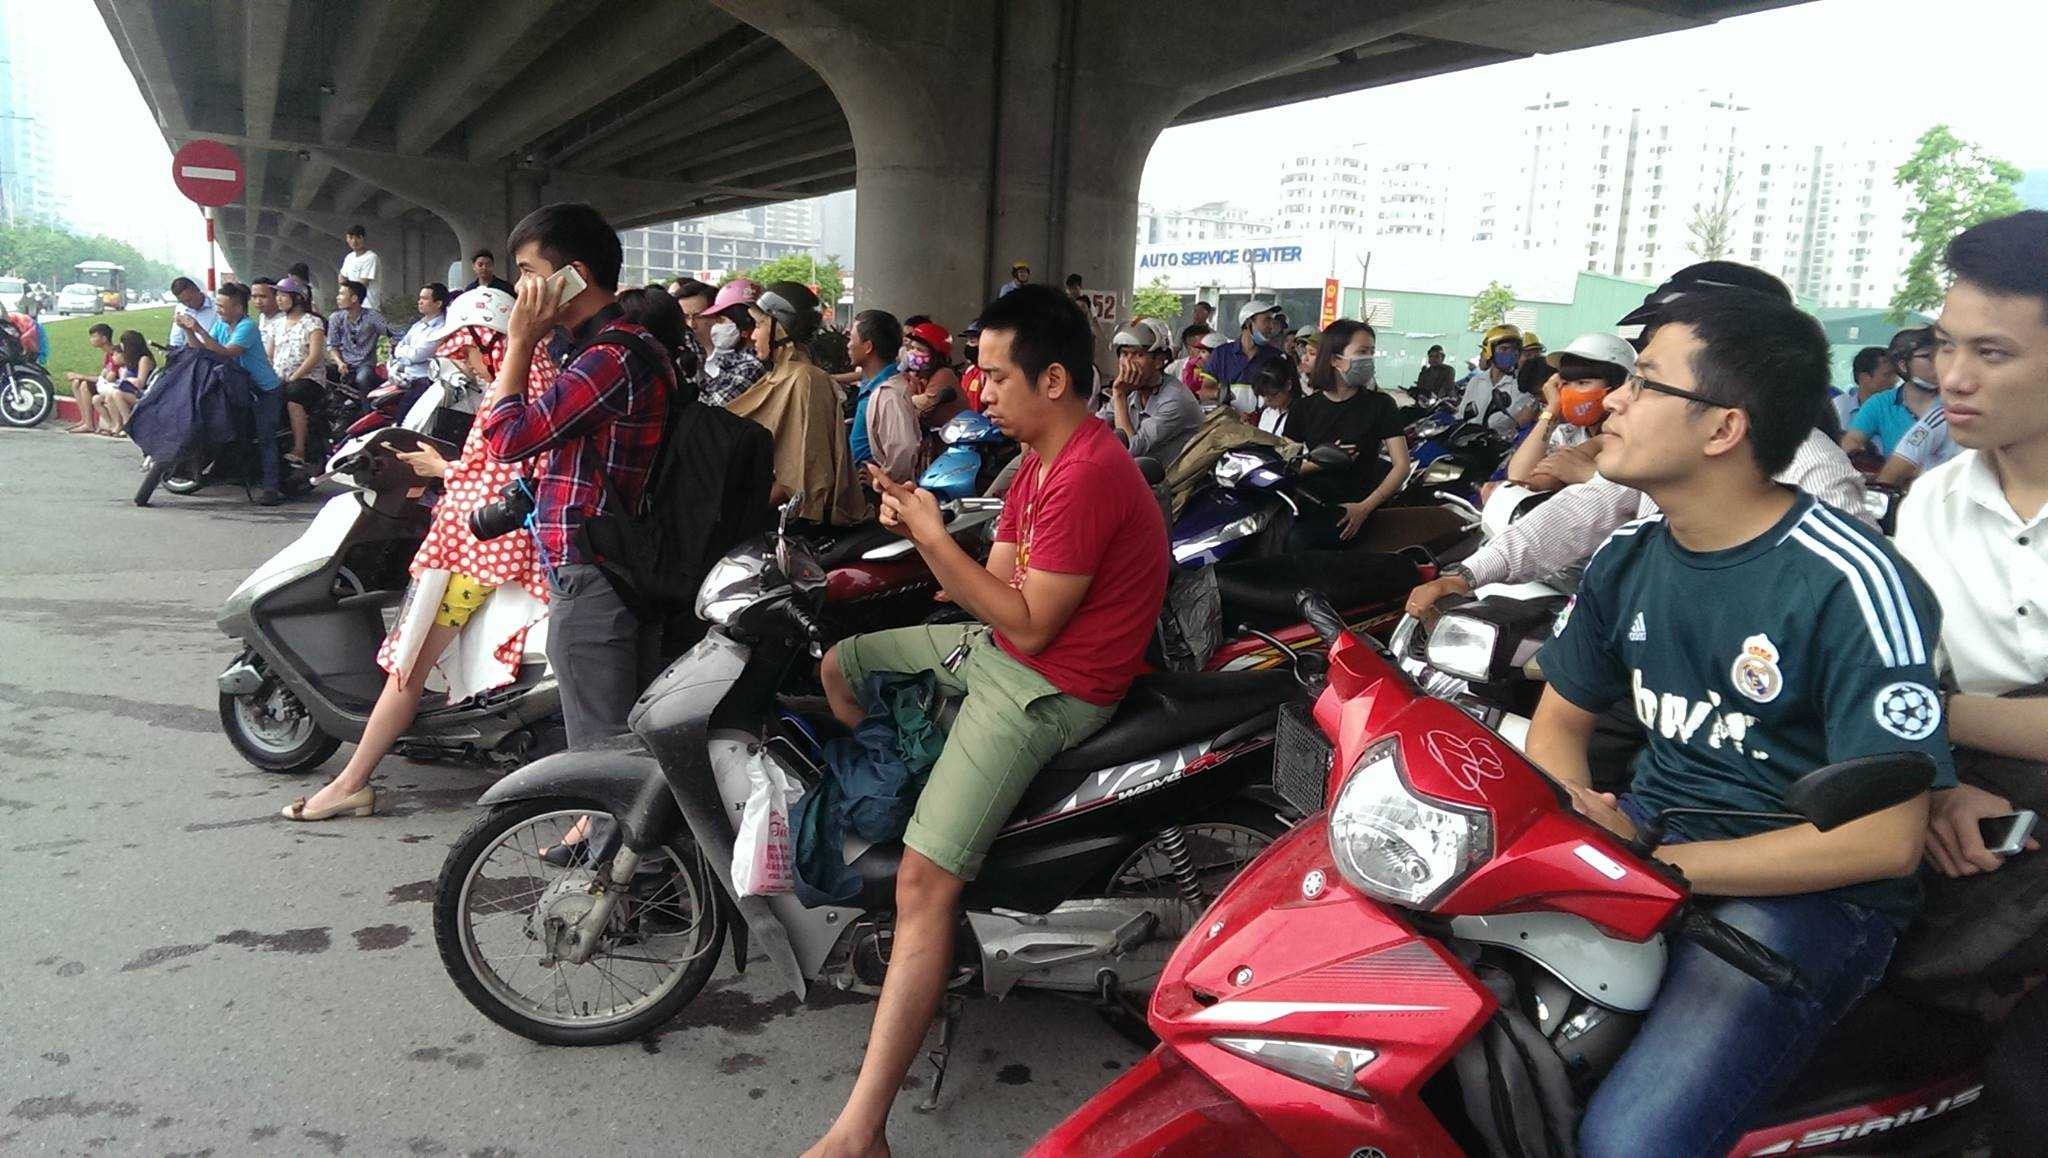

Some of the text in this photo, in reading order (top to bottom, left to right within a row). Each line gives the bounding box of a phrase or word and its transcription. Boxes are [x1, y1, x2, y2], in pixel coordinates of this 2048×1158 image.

[1139, 246, 1302, 268] AUTO SERVICE CENTER
[1797, 1083, 1985, 1150] SIRIUS
